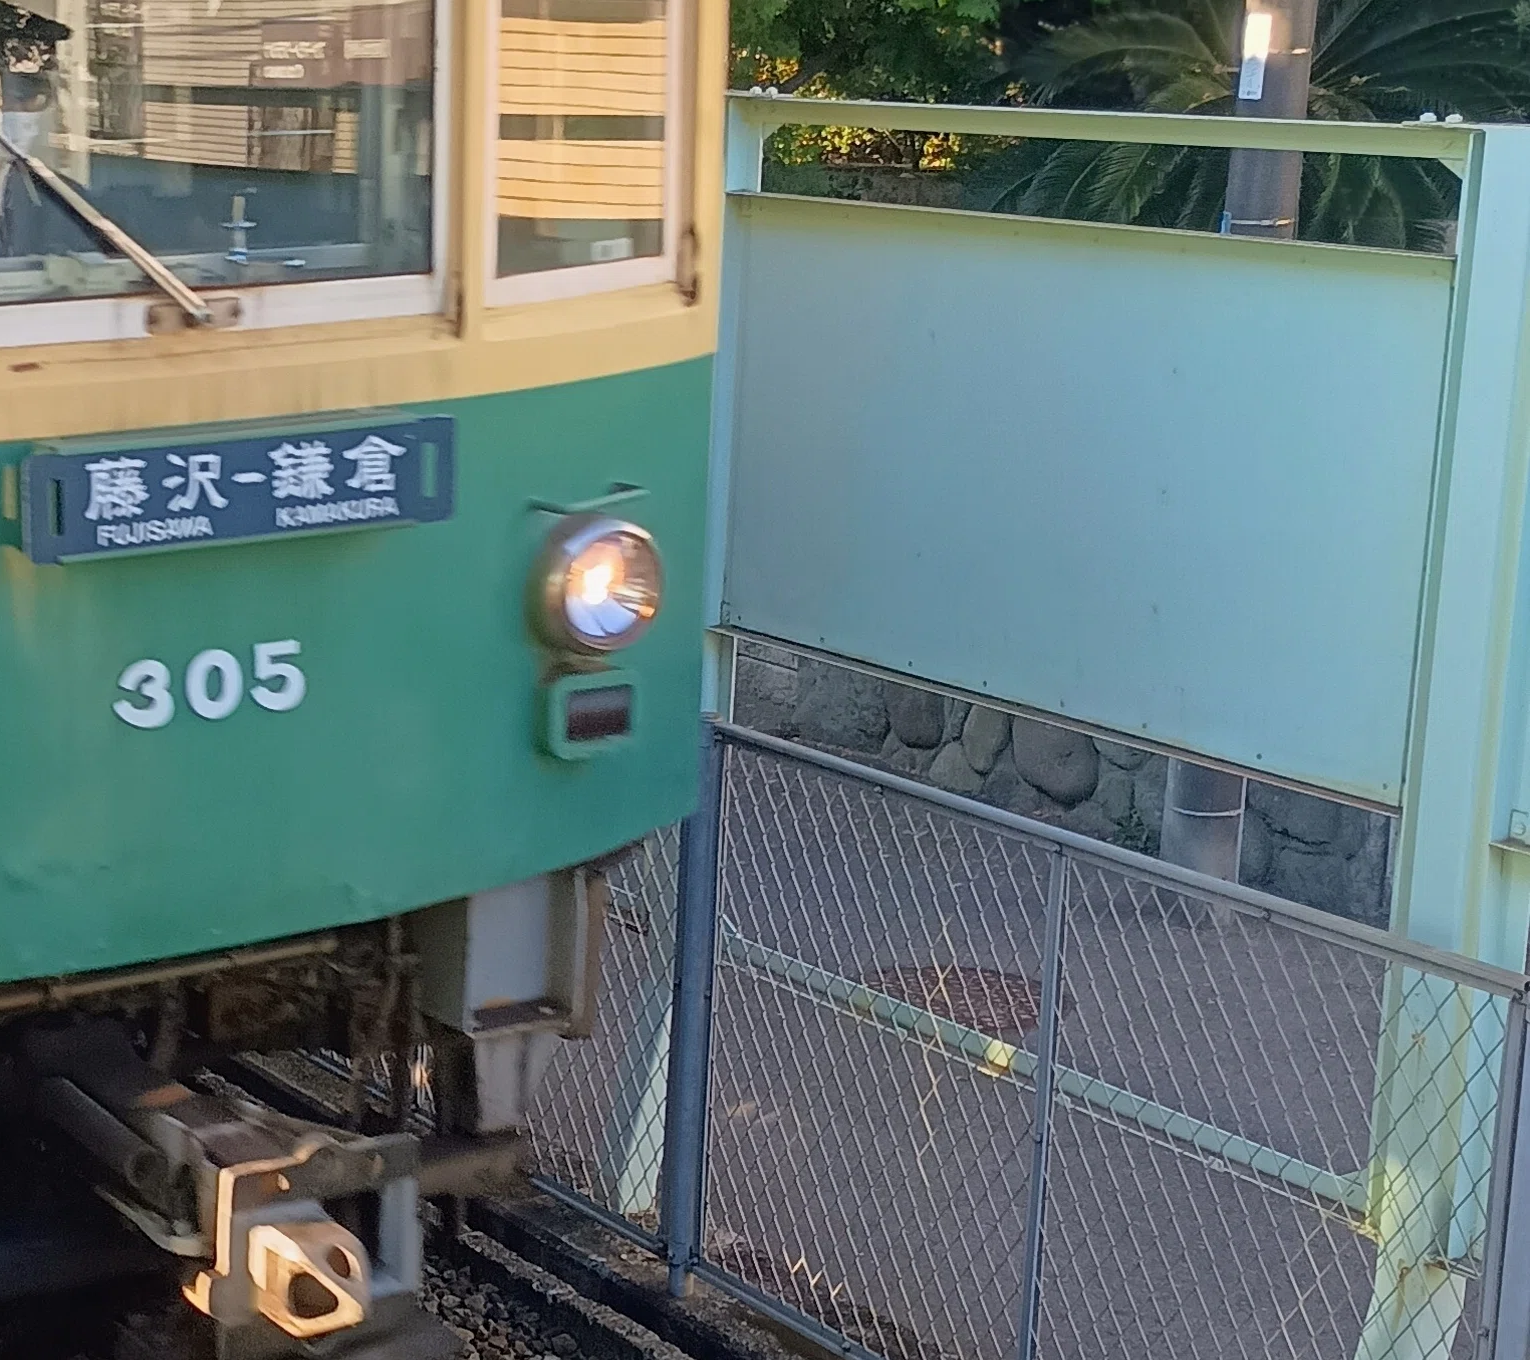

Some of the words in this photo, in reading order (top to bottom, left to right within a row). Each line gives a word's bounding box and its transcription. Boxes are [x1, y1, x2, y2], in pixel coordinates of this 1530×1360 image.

[96, 515, 215, 547] FUJISAWA
[275, 496, 400, 528] KAMAKURA
[112, 638, 307, 729] 305
